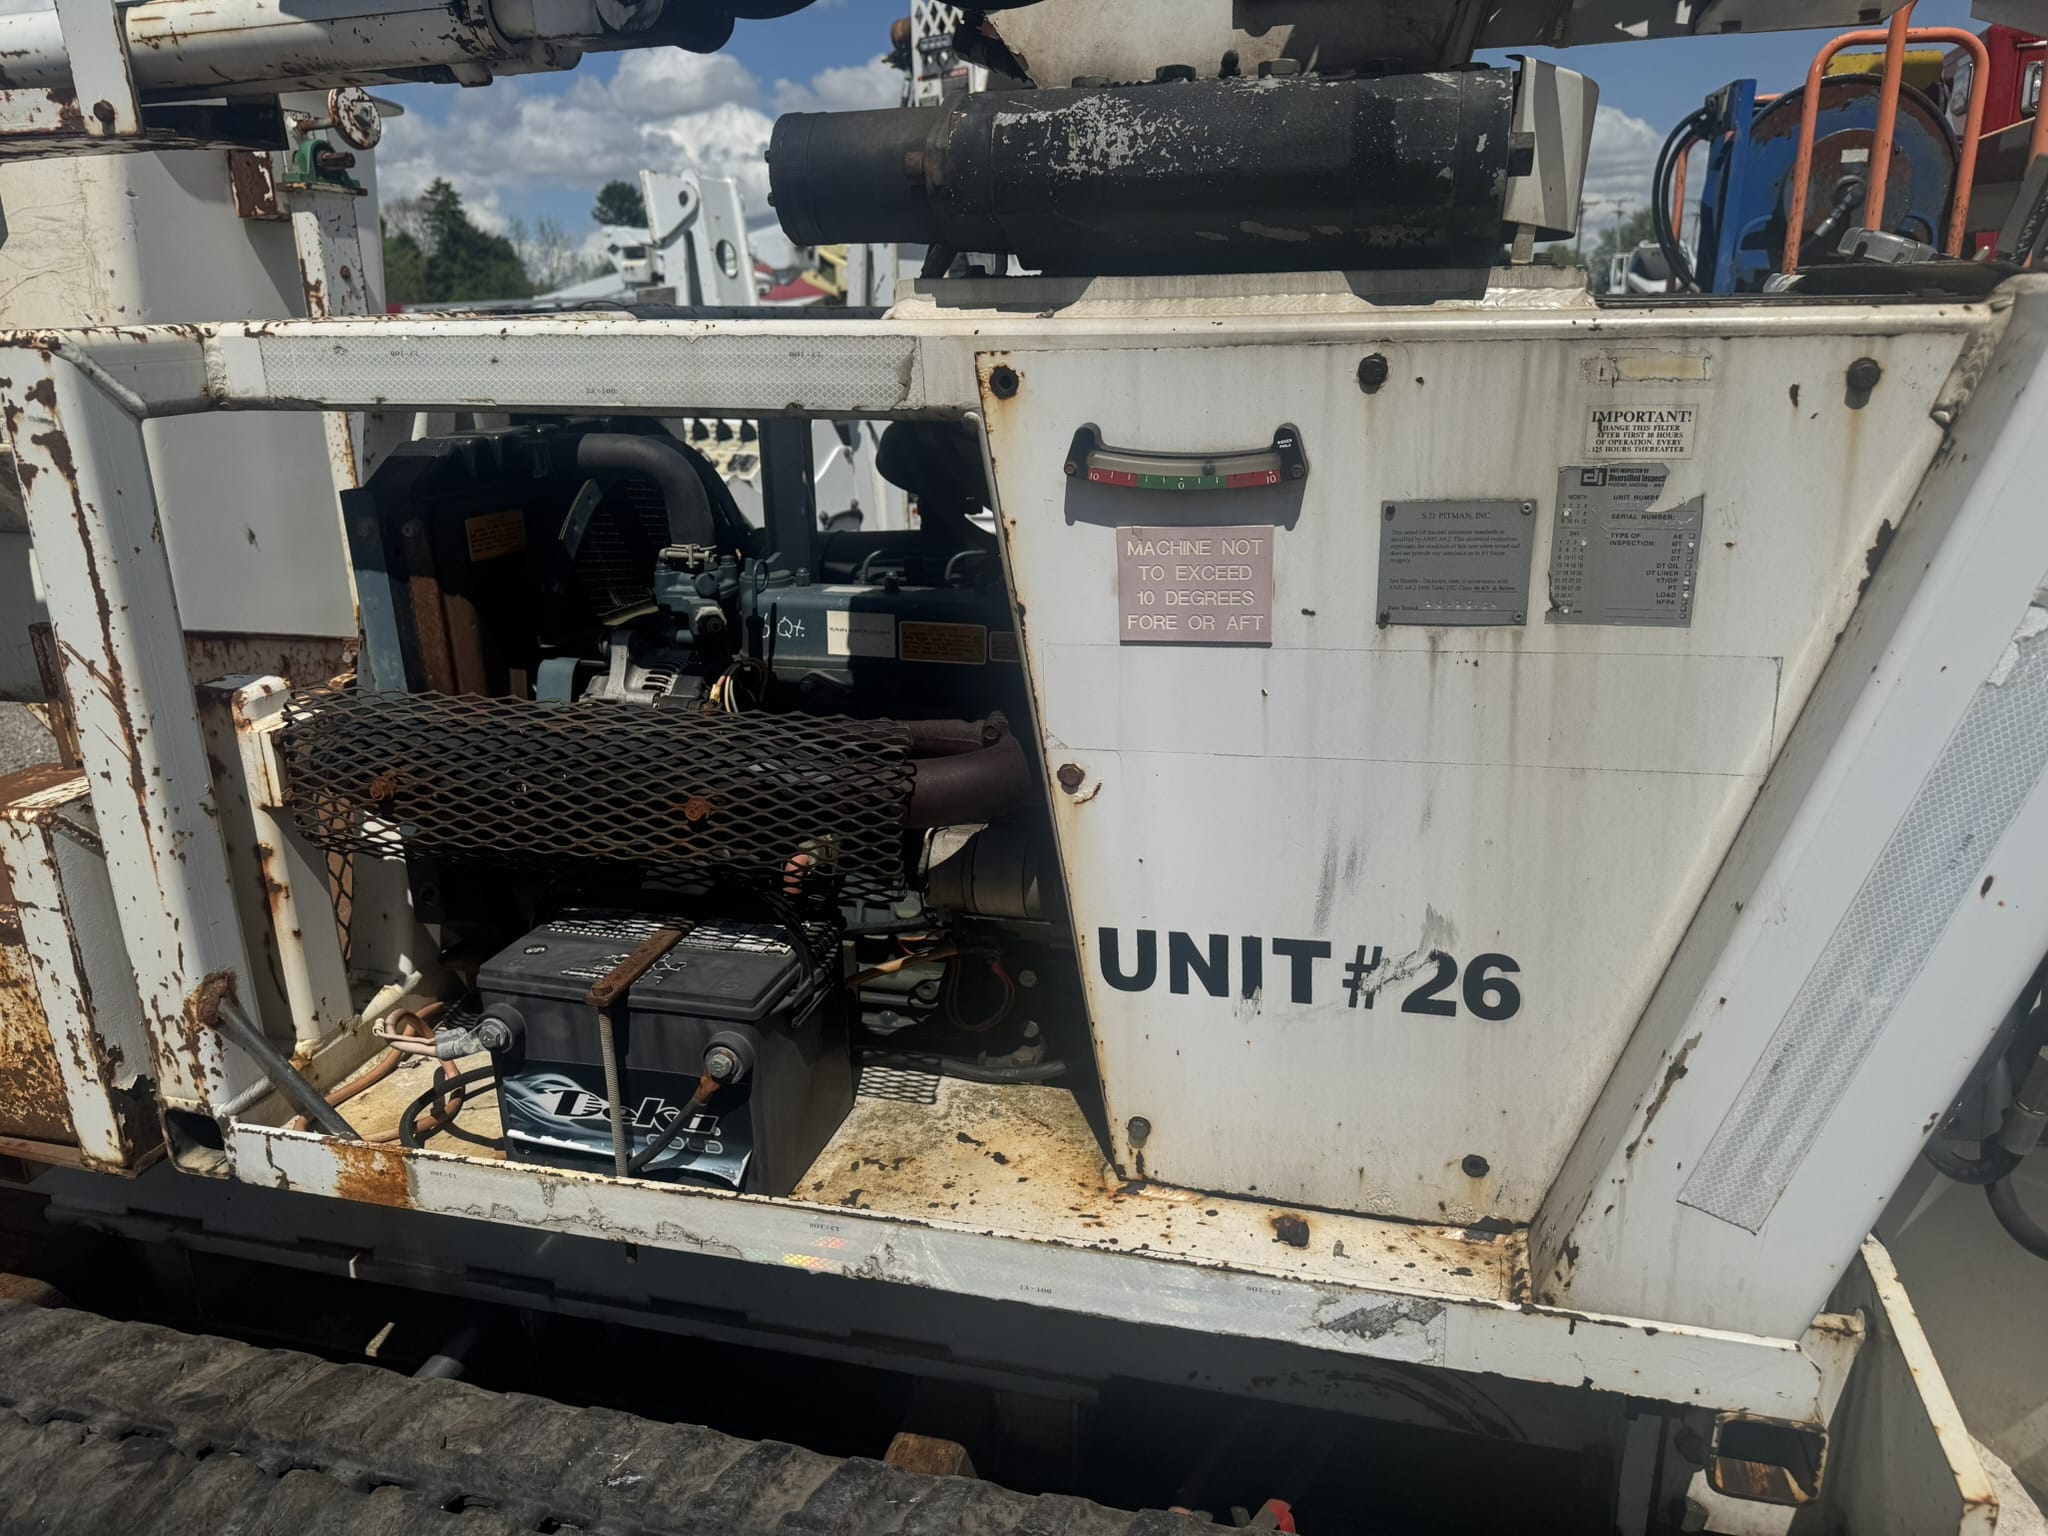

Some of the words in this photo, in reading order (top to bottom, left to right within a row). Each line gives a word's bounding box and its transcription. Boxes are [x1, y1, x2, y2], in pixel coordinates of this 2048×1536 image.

[1592, 410, 1692, 423] IMPORTANT!
[1089, 473, 1099, 481] 10
[1266, 474, 1277, 484] 10
[1178, 482, 1185, 490] 0
[1127, 538, 1212, 557] MACHINE
[1222, 538, 1264, 556] NOT
[1139, 566, 1165, 581] TO
[1176, 566, 1253, 581] EXCEED
[1137, 591, 1155, 606] 10
[1166, 591, 1255, 606] DEGREES
[777, 616, 805, 638] Qt.
[1127, 616, 1179, 631] FORE
[1189, 616, 1215, 631] OR
[1227, 616, 1264, 631] AFT
